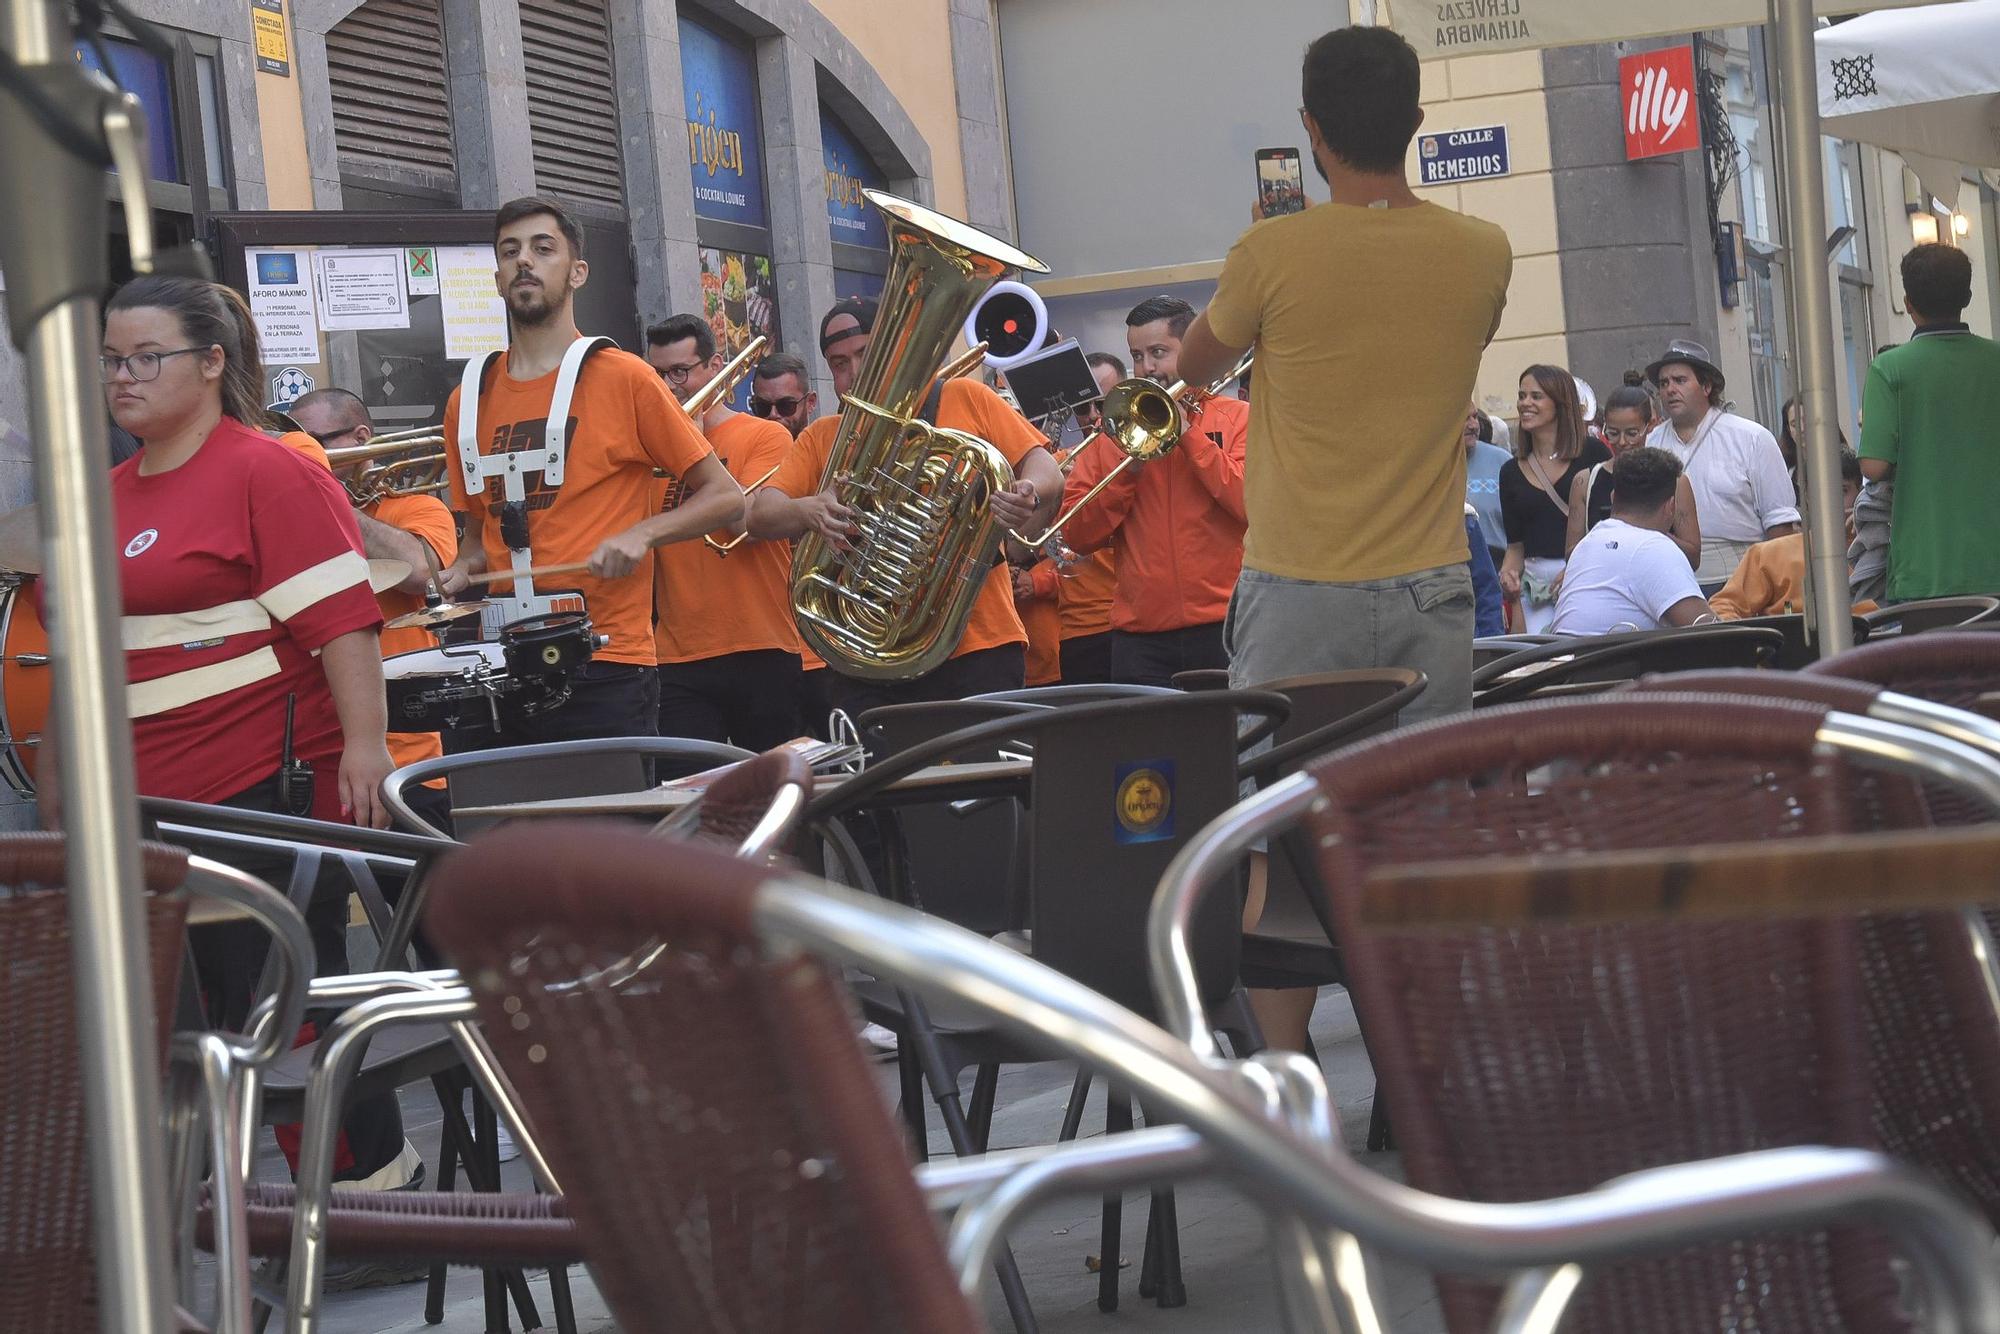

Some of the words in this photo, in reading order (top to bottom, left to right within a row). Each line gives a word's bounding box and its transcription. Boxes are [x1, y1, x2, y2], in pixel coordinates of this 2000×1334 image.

[1628, 67, 1689, 145] illy
[687, 90, 744, 178] rigen
[1448, 129, 1494, 146] CALLE
[1427, 154, 1502, 181] REMEDIOS
[700, 187, 725, 203] COCKTAIL
[725, 191, 746, 207] LOUNGE
[252, 290, 278, 298] AFORO
[278, 288, 308, 297] MÁXIMO
